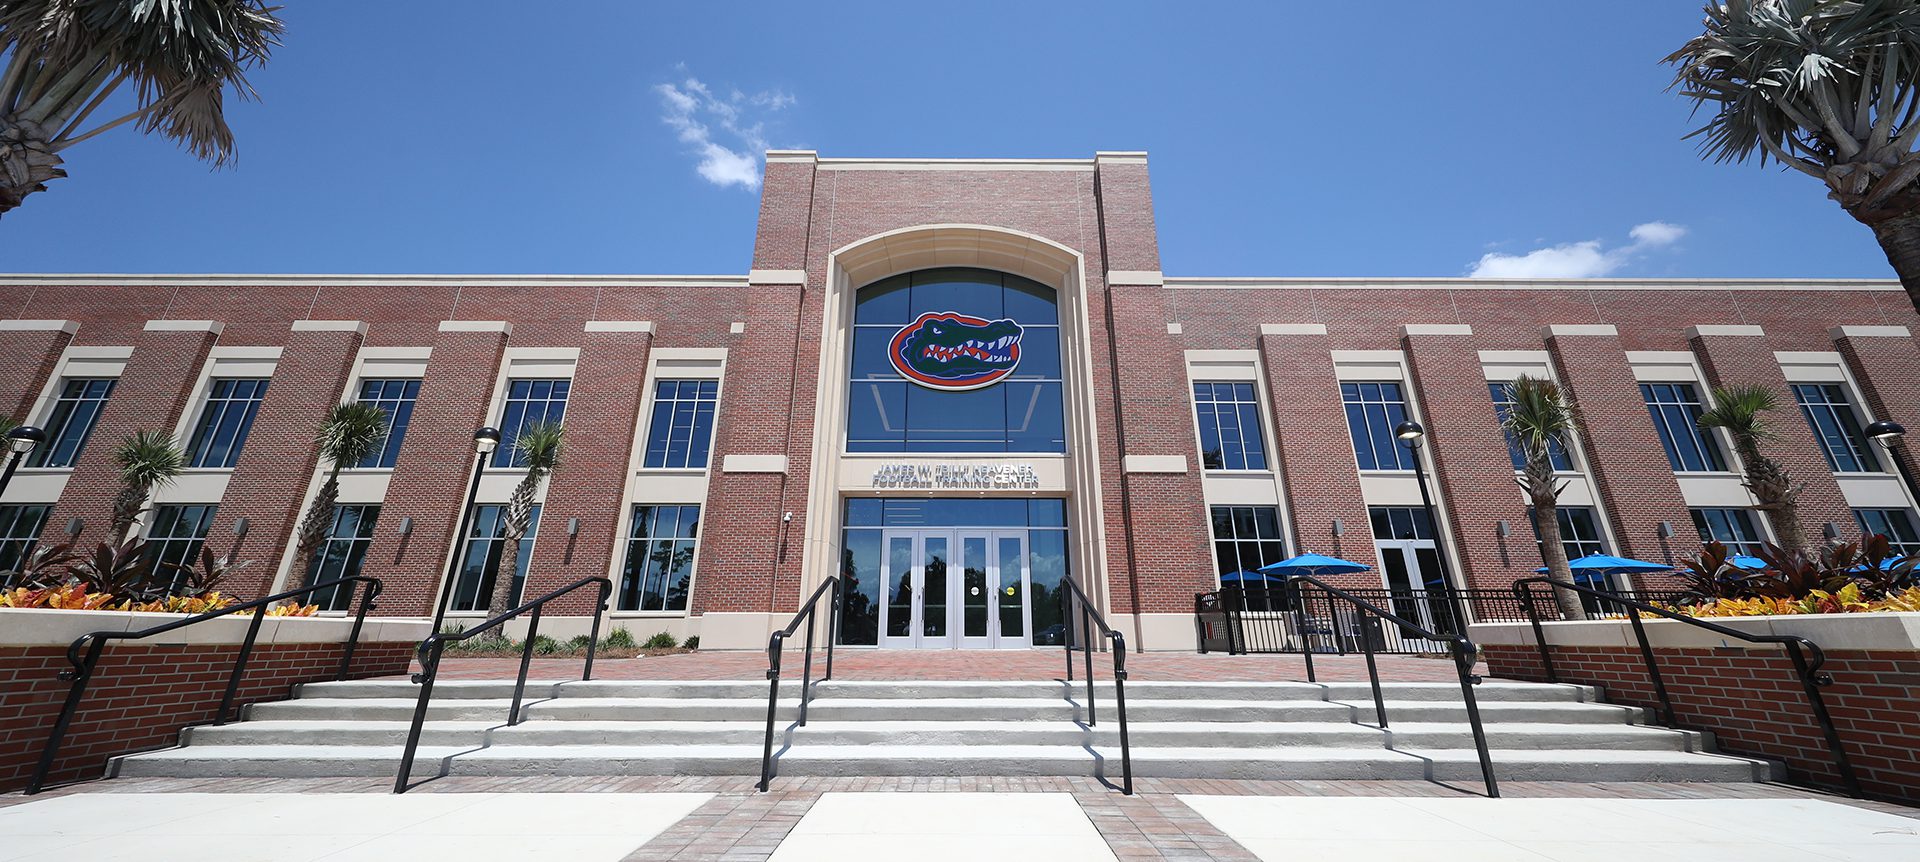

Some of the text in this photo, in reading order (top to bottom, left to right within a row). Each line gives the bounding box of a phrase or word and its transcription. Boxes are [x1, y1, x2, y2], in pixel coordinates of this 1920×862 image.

[877, 464, 914, 475] JAMES
[871, 474, 1039, 485] FOOTBALL TRAINING CENTER
